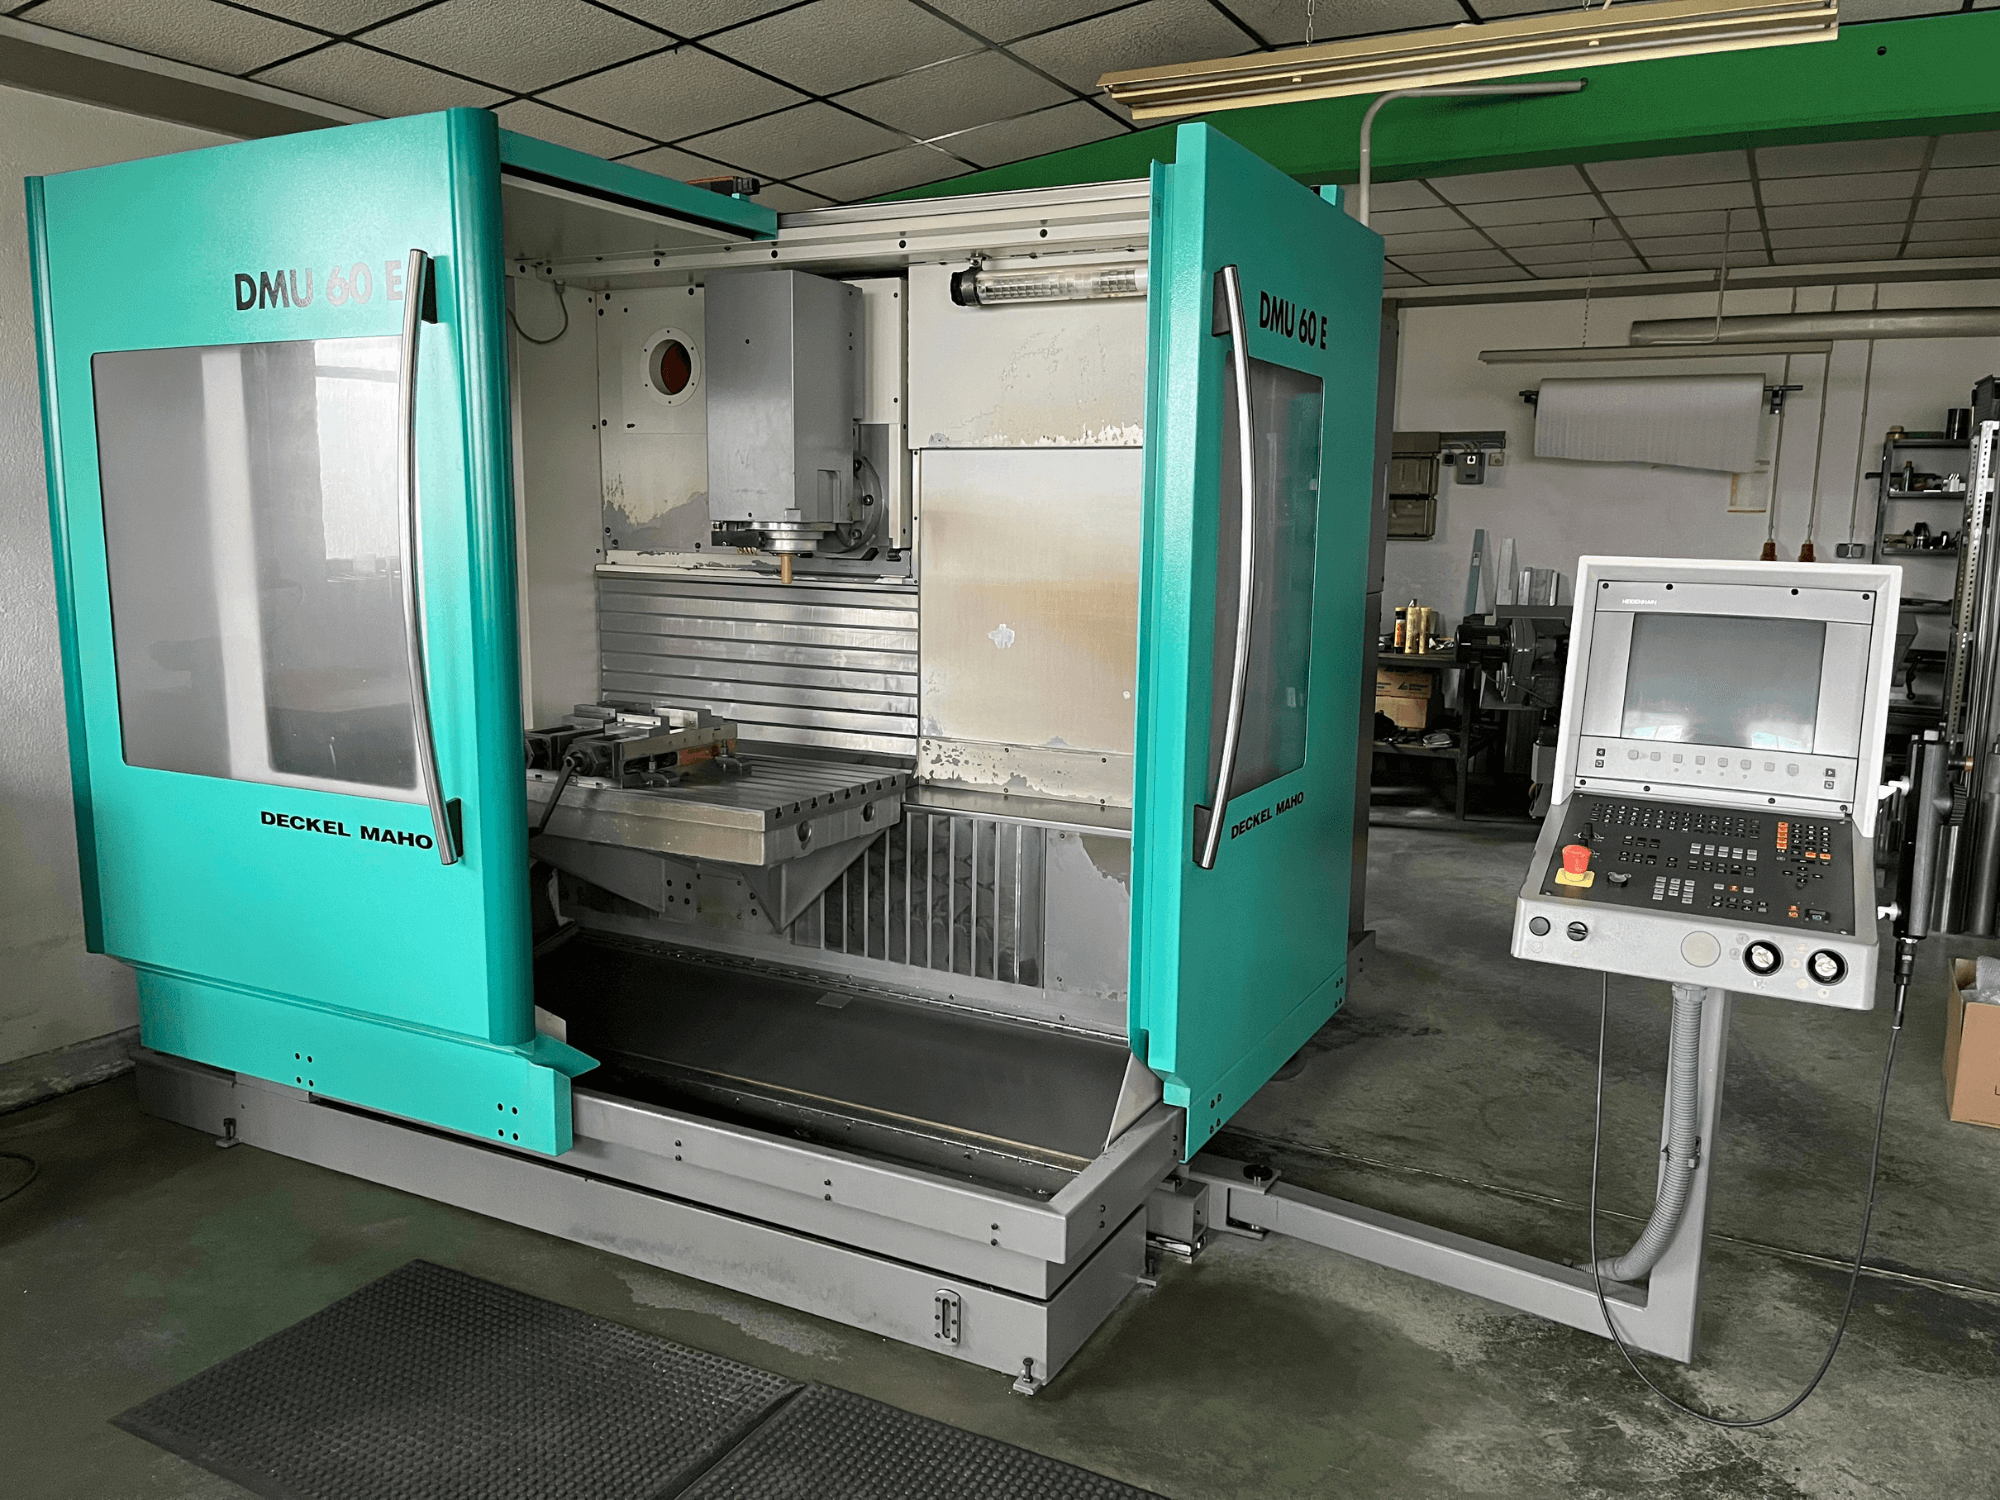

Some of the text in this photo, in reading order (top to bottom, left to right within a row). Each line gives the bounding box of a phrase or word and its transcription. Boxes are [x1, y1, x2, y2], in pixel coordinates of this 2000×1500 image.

[235, 260, 403, 311] DMU 60 E
[1259, 290, 1328, 350] DMU 60 E
[260, 810, 433, 849] DECKEL MAHO
[1231, 792, 1303, 839] DECKEL MAHO
